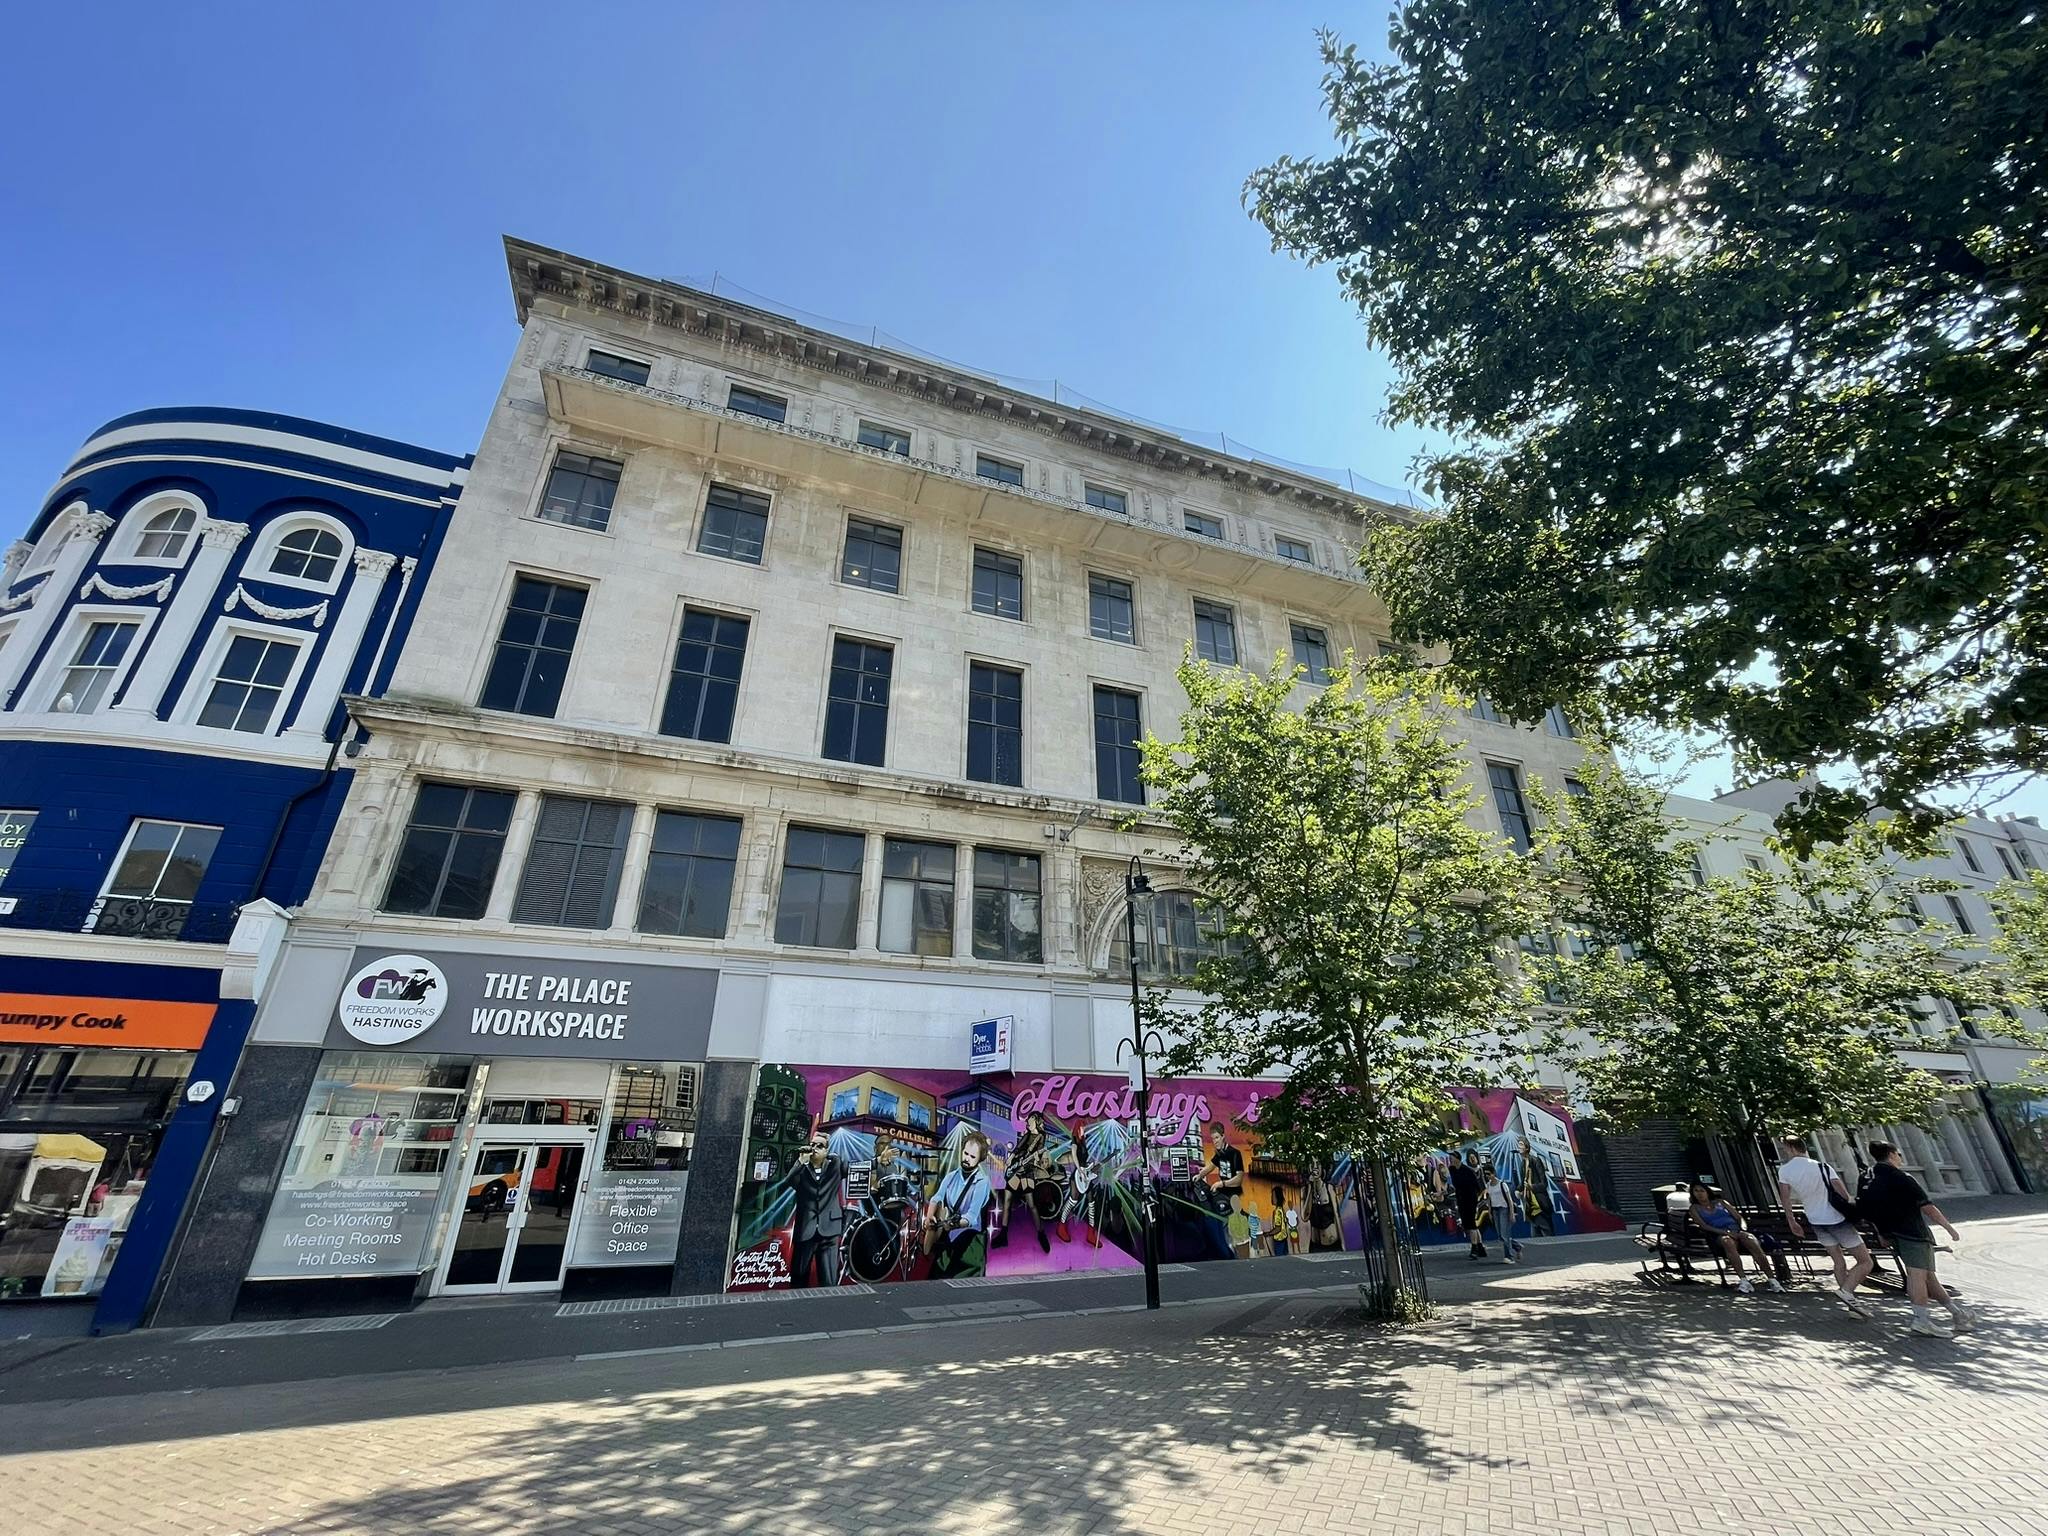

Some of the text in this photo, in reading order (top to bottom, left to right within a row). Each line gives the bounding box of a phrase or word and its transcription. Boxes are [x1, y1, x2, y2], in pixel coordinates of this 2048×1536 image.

[0, 823, 26, 835] CY
[483, 972, 632, 1005] THE PALACE
[347, 1004, 435, 1017] FREEDOM WORKS
[71, 1012, 128, 1029] Cook
[353, 1017, 423, 1029] HASTINGS
[470, 1007, 628, 1040] WORKSPACE
[973, 1033, 987, 1045] Dyer
[998, 1030, 1007, 1055] LET
[1011, 1075, 1212, 1146] Hastngs
[889, 1127, 933, 1145] CARLISLE
[300, 1200, 408, 1209] www.freedomworks.space
[609, 1204, 658, 1217] Flexible
[304, 1213, 394, 1229] Co-Working
[611, 1221, 649, 1235] Office
[282, 1231, 402, 1249] Meeting Rooms
[607, 1239, 648, 1255] Space
[297, 1250, 377, 1266] Hot Desks
